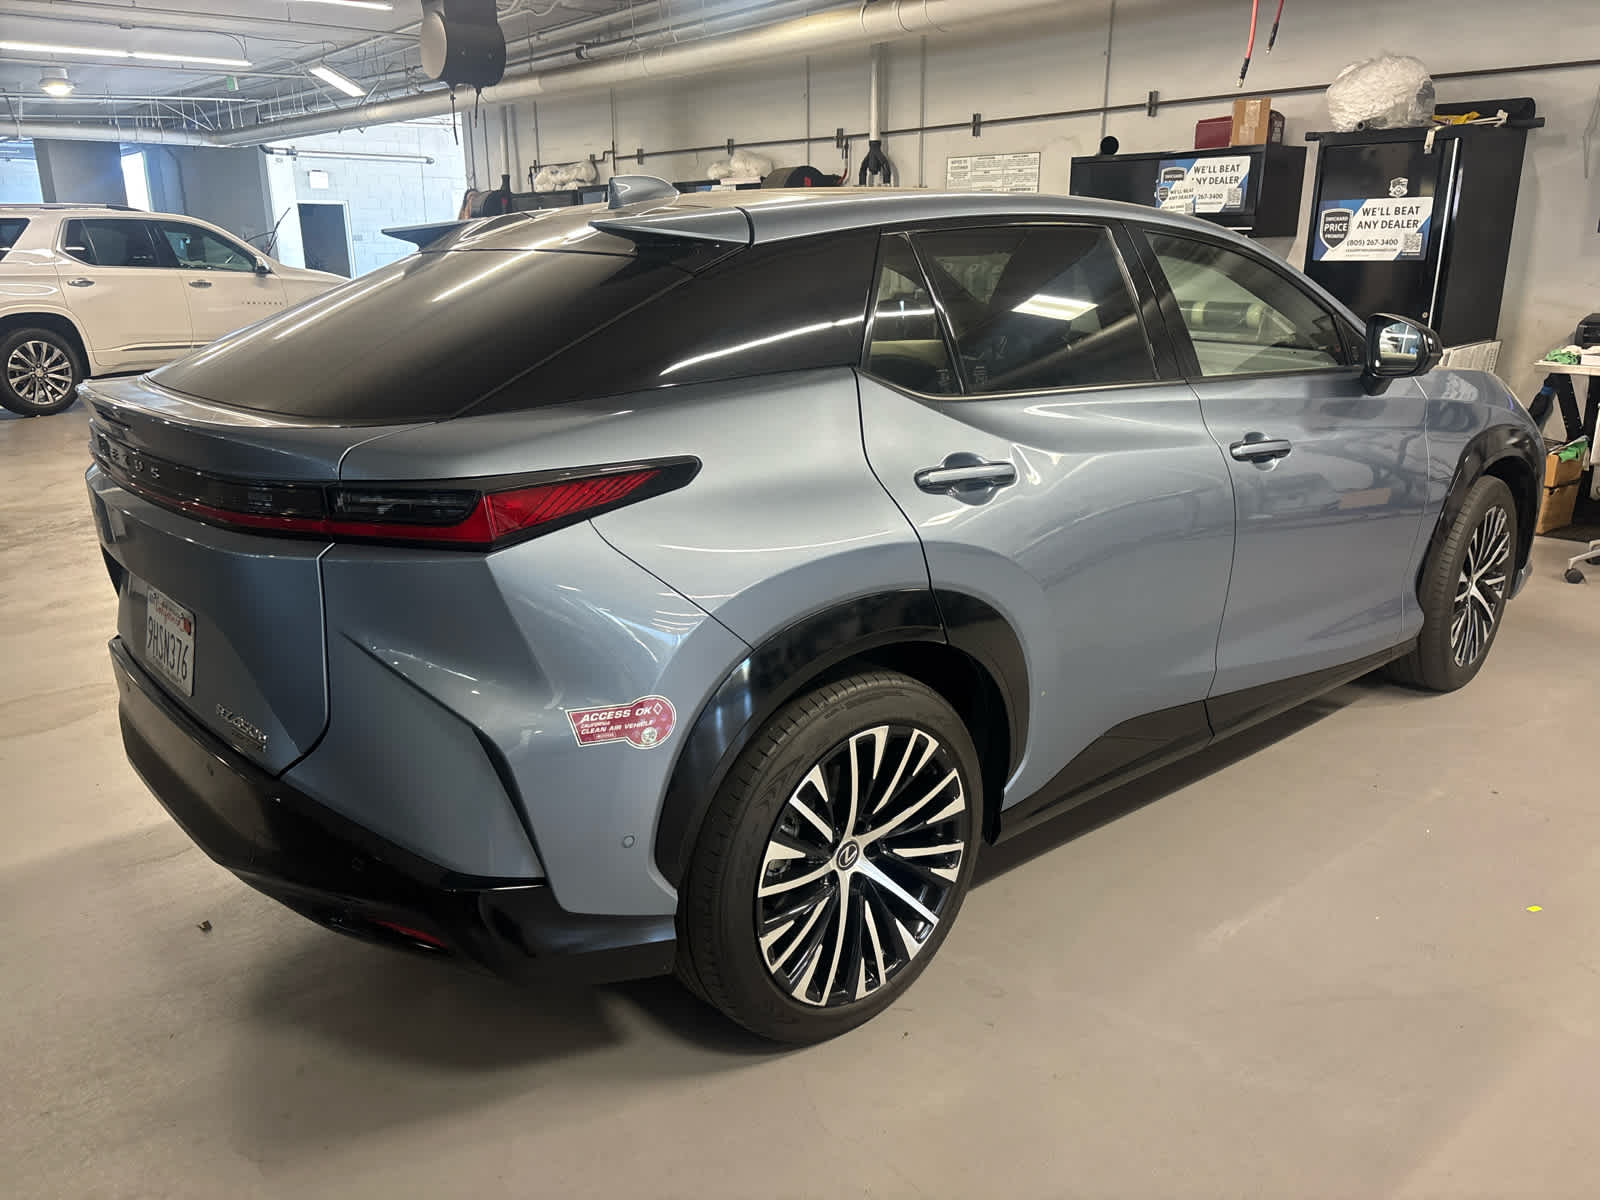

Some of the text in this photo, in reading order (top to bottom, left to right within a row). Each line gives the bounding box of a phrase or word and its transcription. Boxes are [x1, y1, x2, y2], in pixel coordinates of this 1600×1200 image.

[1194, 164, 1240, 174] WE'LL BEAT
[1209, 176, 1239, 184] DEALER
[1362, 206, 1420, 217] WE'LL BEAT
[1324, 222, 1348, 232] PRICE
[1357, 219, 1419, 230] ANY DEALER
[147, 615, 189, 681] 9HSN376
[580, 706, 653, 723] ACCESS OK
[581, 726, 607, 736] CLEAN
[609, 724, 622, 732] AIR
[624, 720, 653, 730] VEHICLE
